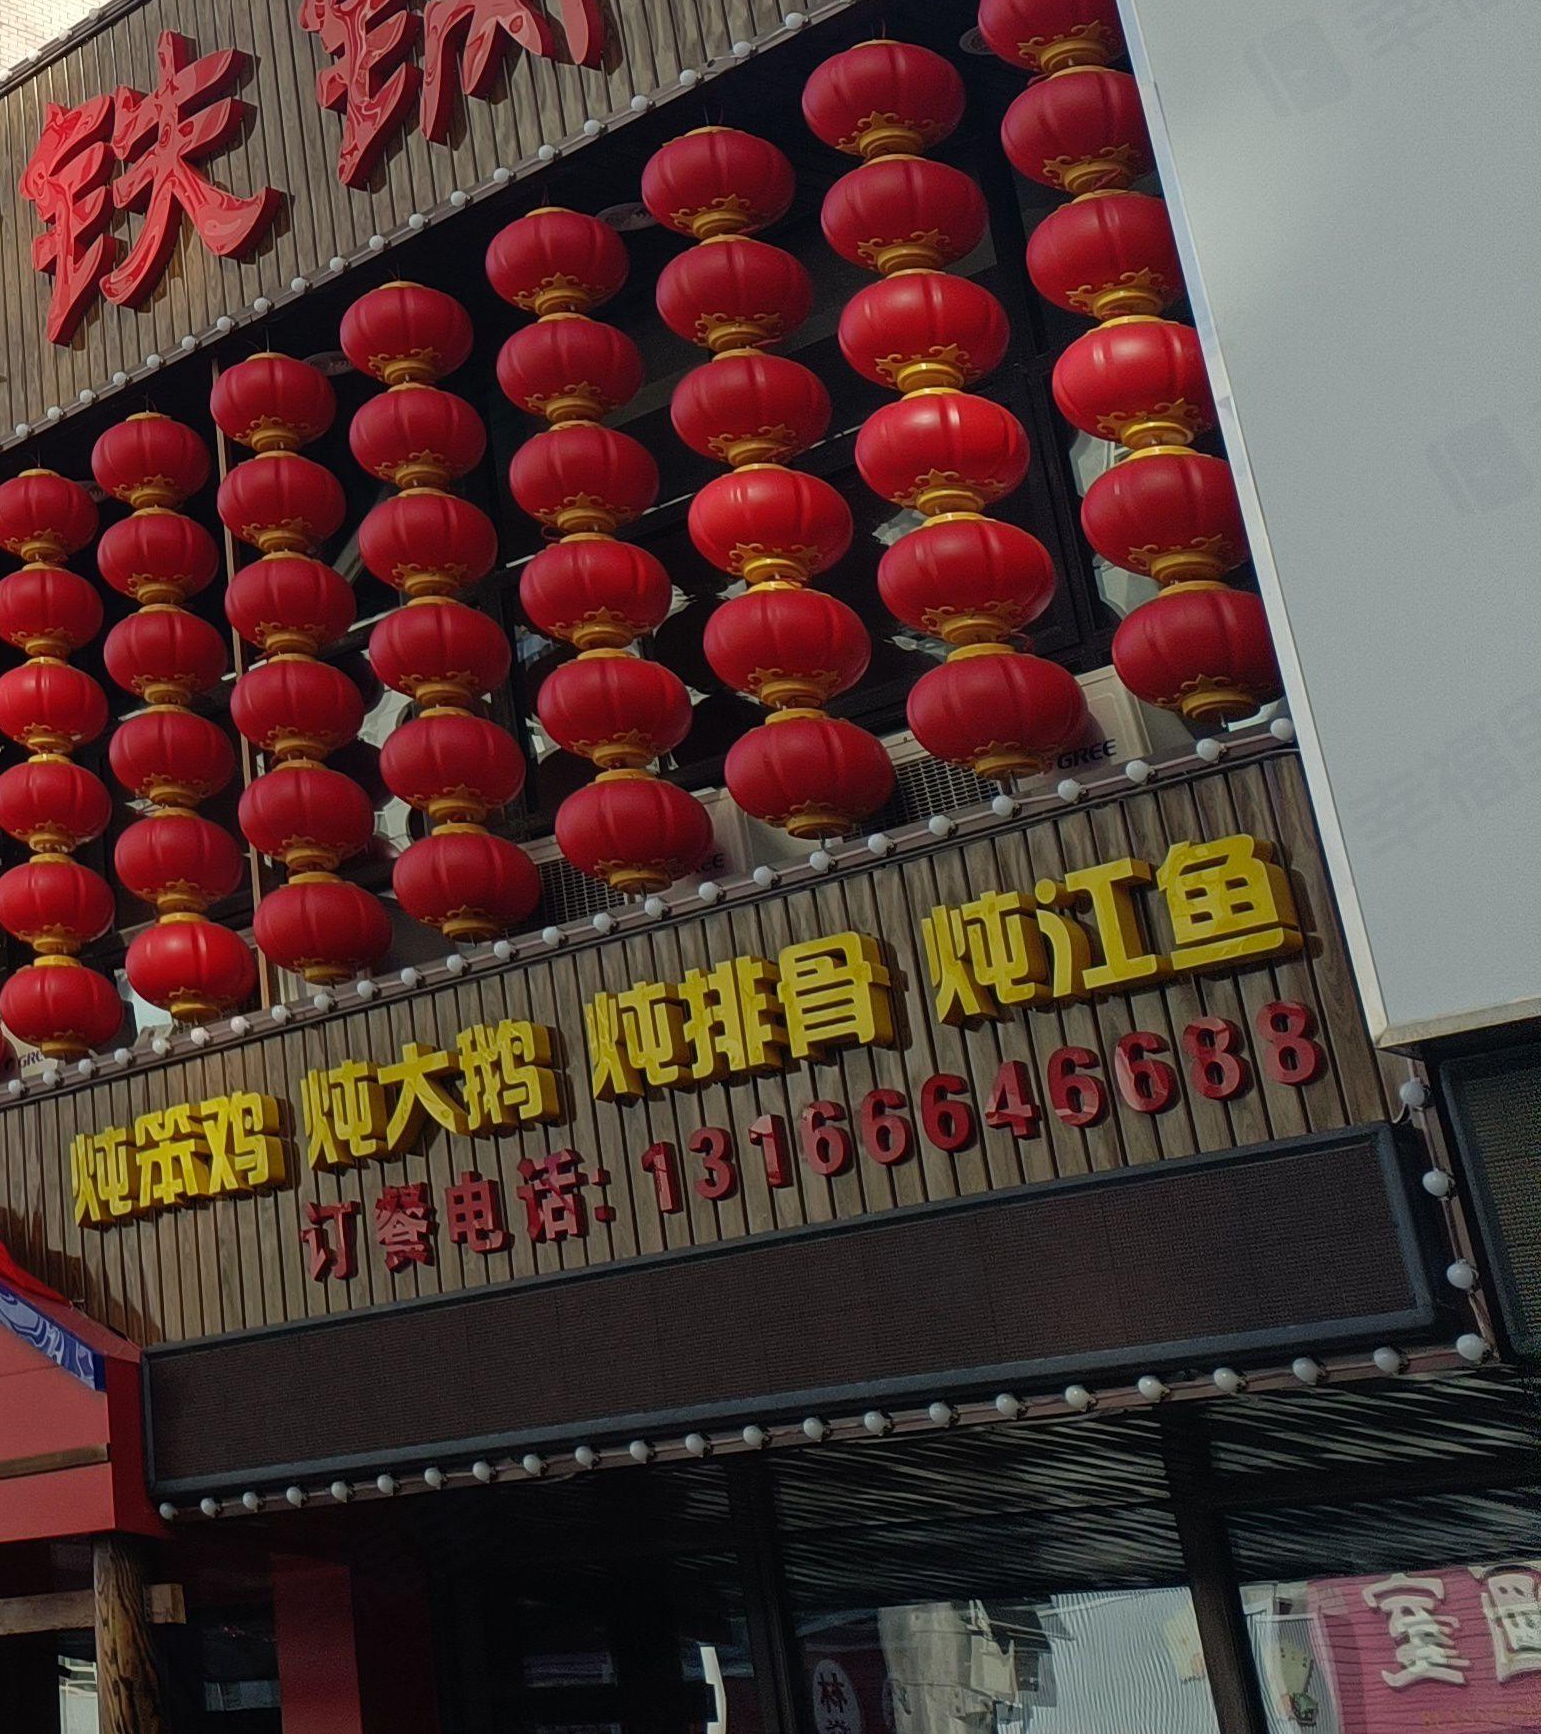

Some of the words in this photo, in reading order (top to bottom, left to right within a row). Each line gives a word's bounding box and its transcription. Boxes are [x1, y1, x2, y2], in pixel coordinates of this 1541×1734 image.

[1056, 738, 1117, 770] GREE
[70, 1089, 284, 1229] 炖笨鸡
[301, 1017, 562, 1172] 炖大鹅
[585, 930, 893, 1106] 炖排骨
[921, 832, 1303, 1028] 炖江鱼
